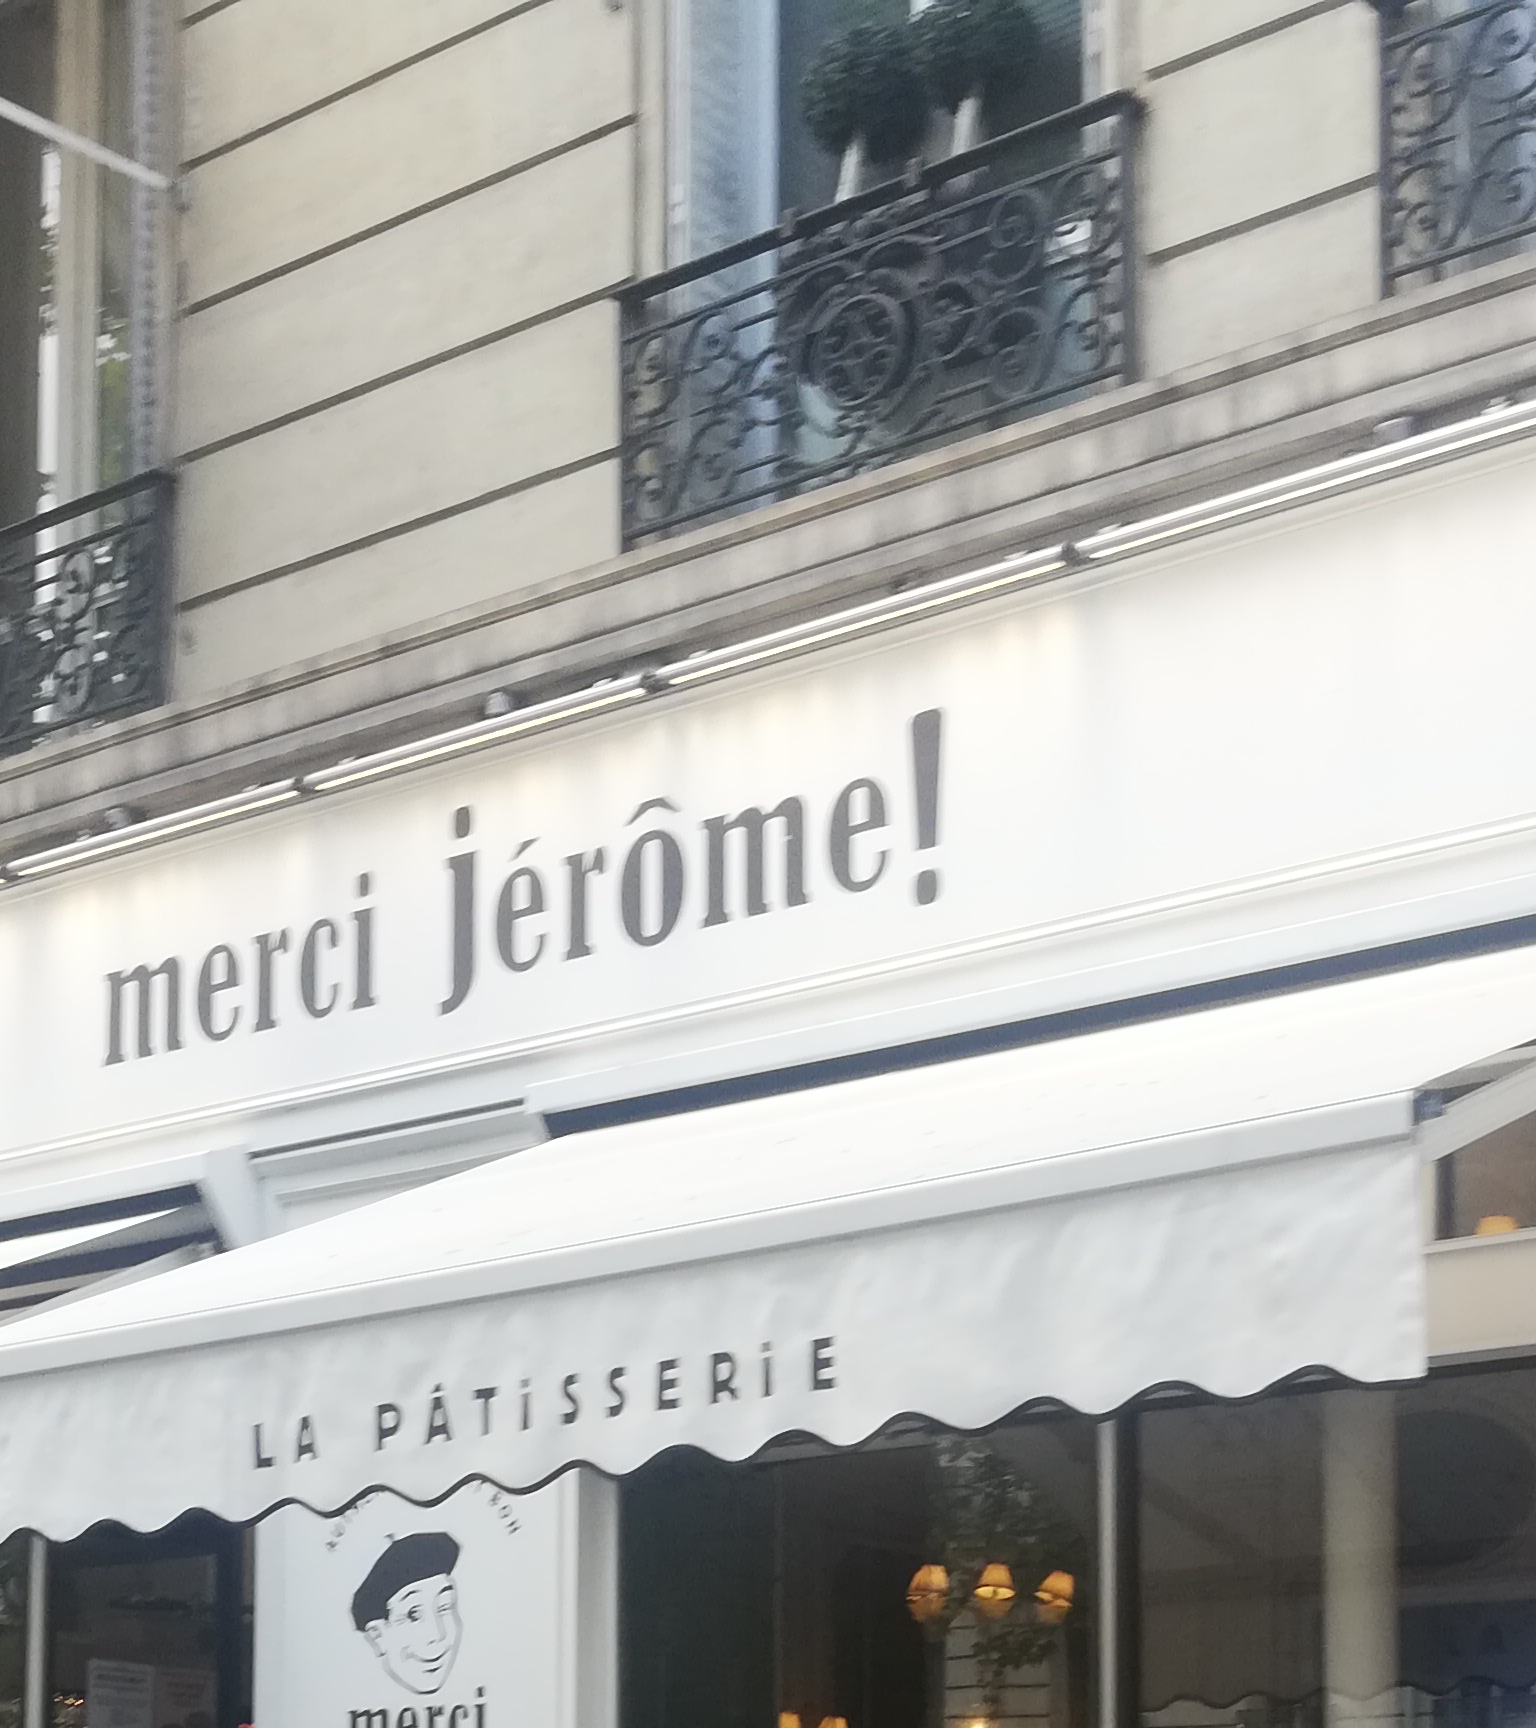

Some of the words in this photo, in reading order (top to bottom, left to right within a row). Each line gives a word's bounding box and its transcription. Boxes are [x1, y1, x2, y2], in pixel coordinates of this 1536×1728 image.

[101, 872, 380, 1067] merci
[438, 707, 945, 1016] jérôme!
[252, 1415, 319, 1469] LA
